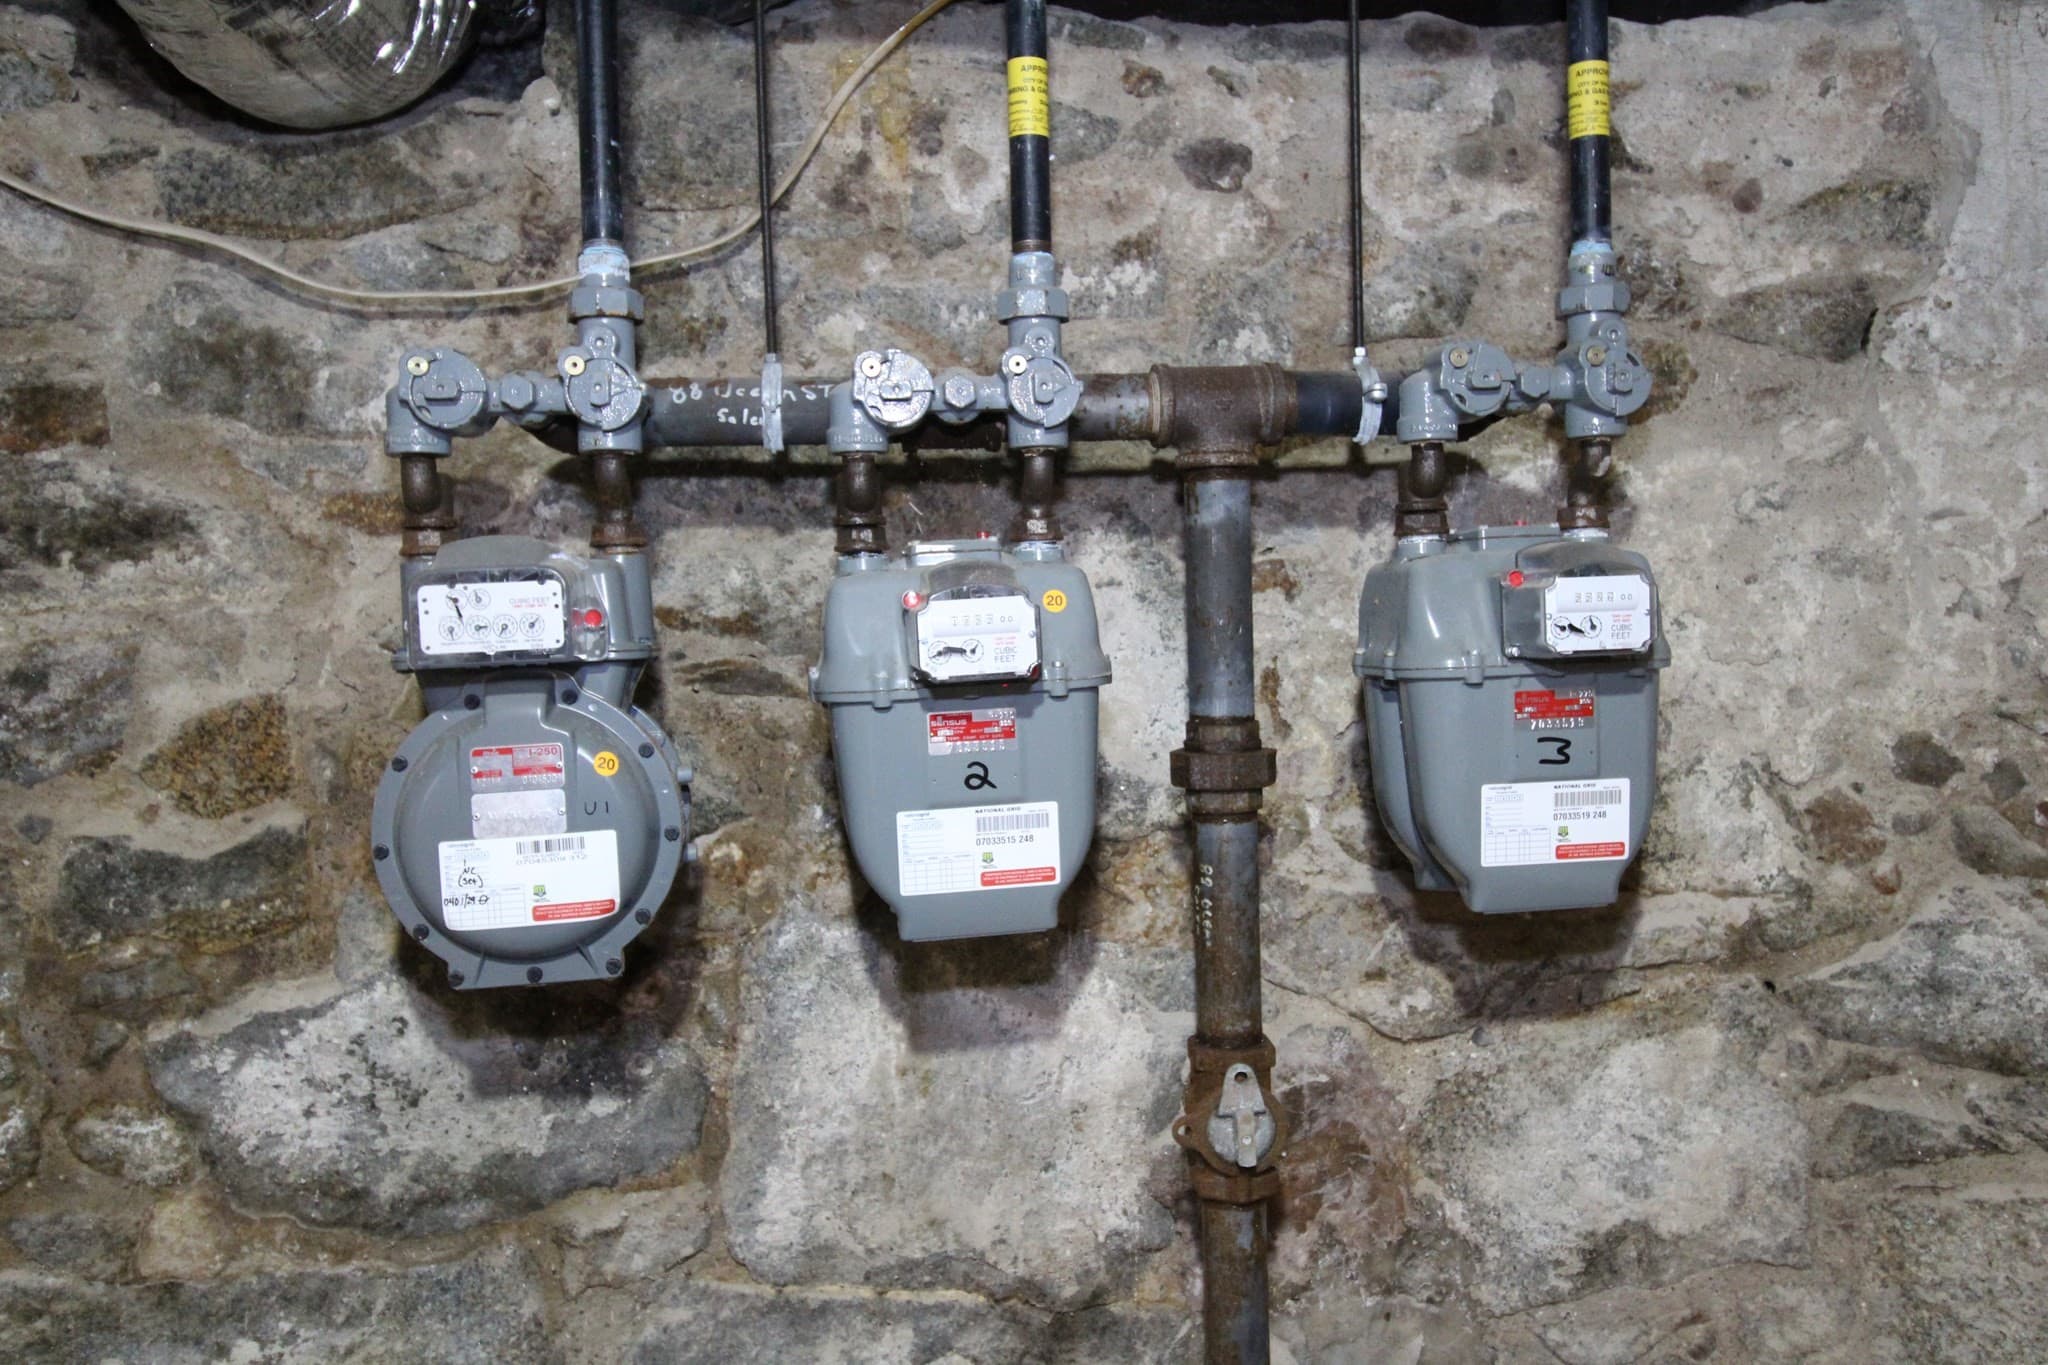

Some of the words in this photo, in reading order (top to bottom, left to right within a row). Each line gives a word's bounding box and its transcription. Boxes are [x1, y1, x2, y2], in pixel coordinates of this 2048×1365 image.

[714, 383, 797, 402] Ocen
[717, 408, 763, 426] Sale
[1046, 595, 1063, 607] 20
[1611, 632, 1631, 640] FEET
[994, 646, 1017, 655] CUBIC
[994, 655, 1016, 663] FEET
[1537, 736, 1572, 765] 3
[597, 757, 615, 770] 20
[964, 761, 997, 790] 2
[976, 835, 1016, 846] 07033515
[1019, 834, 1034, 843] 248
